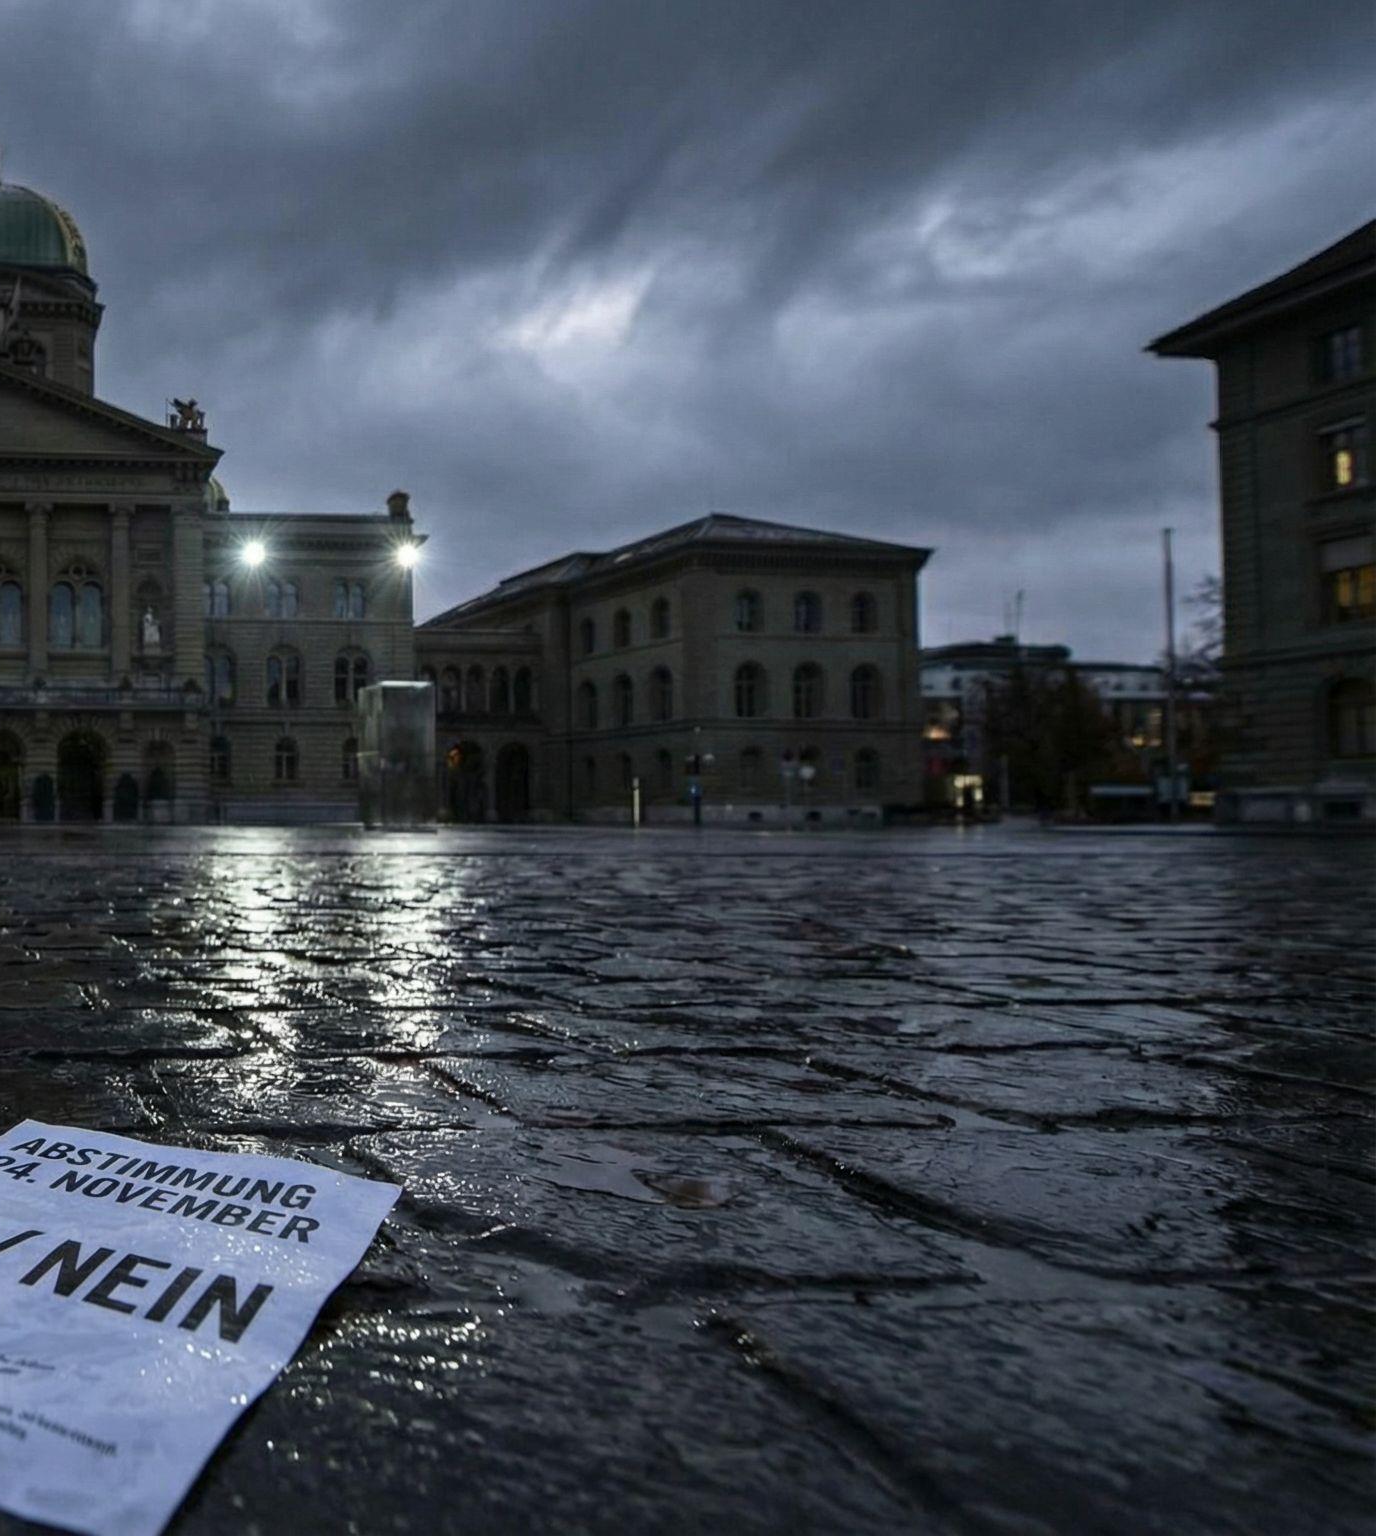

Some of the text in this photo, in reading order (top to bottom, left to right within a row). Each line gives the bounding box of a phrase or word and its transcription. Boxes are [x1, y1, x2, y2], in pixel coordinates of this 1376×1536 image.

[10, 1138, 316, 1210] ABSTIMMUNG
[49, 1170, 320, 1243] NOVEMBER
[19, 1239, 274, 1344] NEIN
